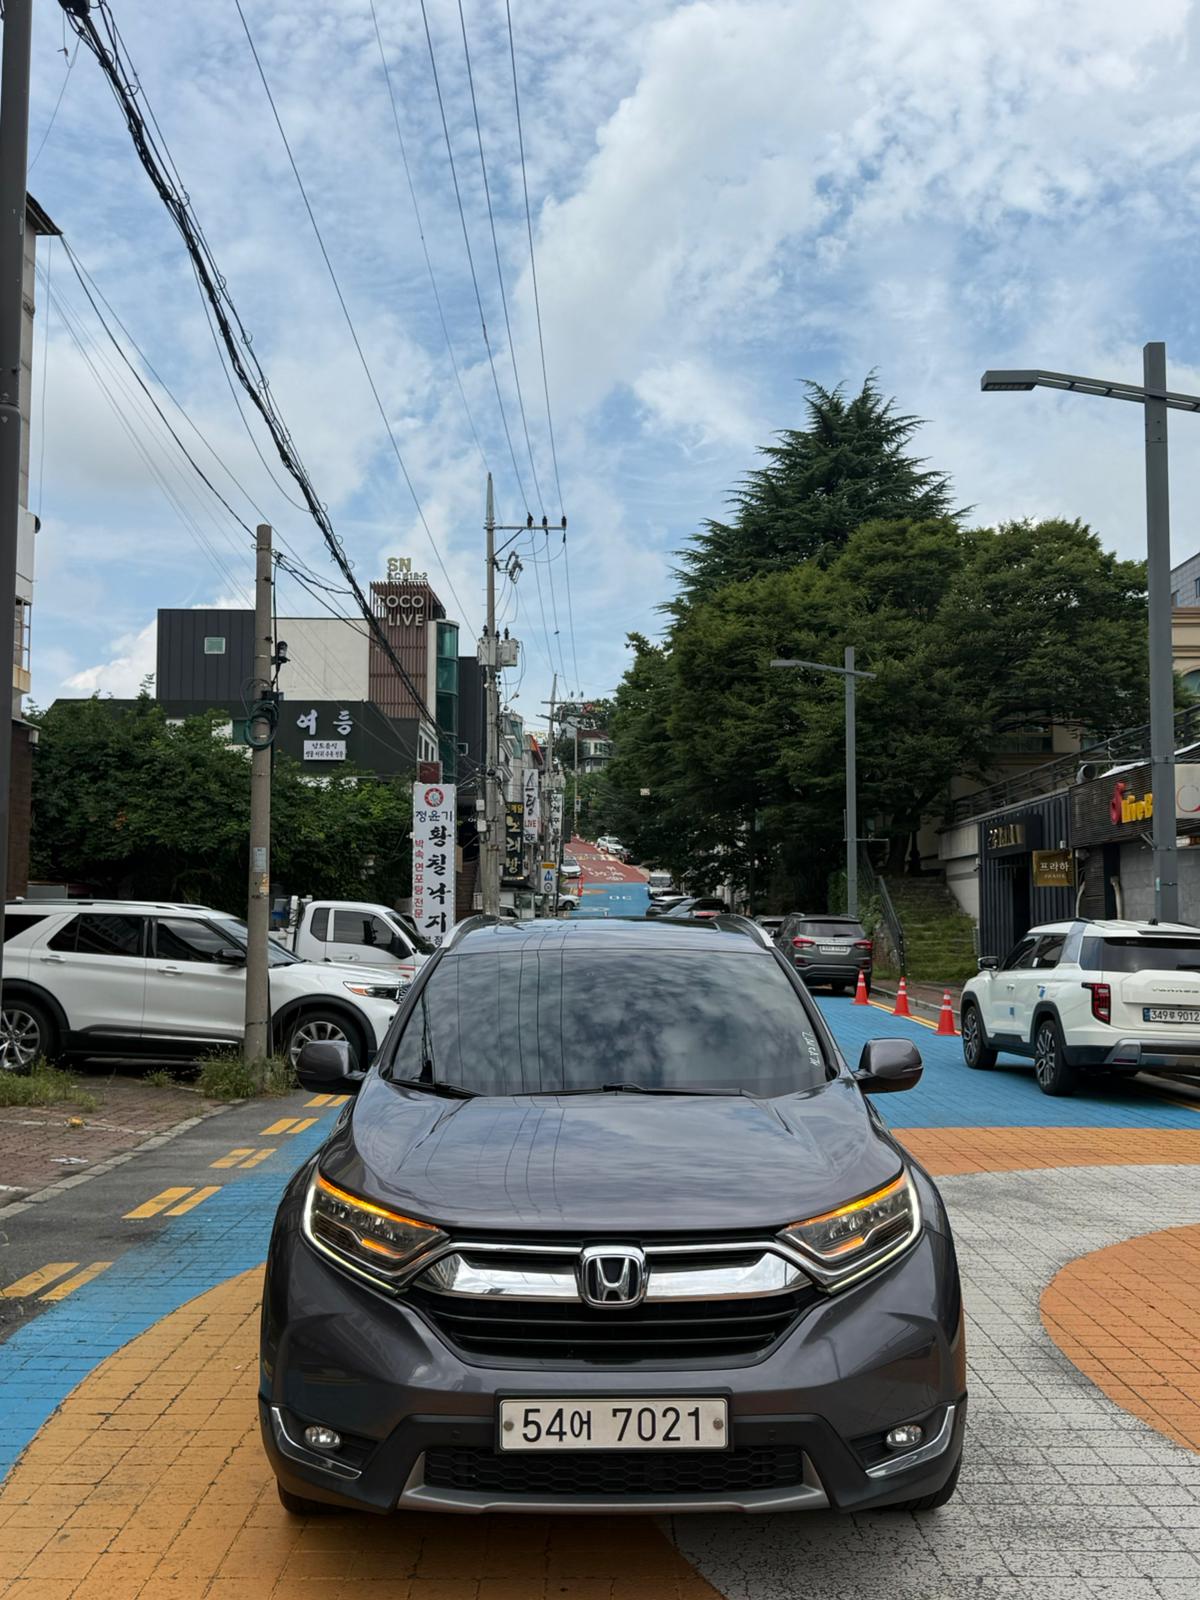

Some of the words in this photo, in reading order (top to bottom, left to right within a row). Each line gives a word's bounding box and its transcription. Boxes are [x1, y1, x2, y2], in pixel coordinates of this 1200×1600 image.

[387, 557, 412, 572] SN
[388, 614, 424, 626] LIVE
[415, 810, 453, 823] 정윤기
[1039, 861, 1070, 872] 프라하
[1177, 1011, 1200, 1021] 9012
[522, 1407, 592, 1443] 54어
[612, 1406, 700, 1442] 7021
